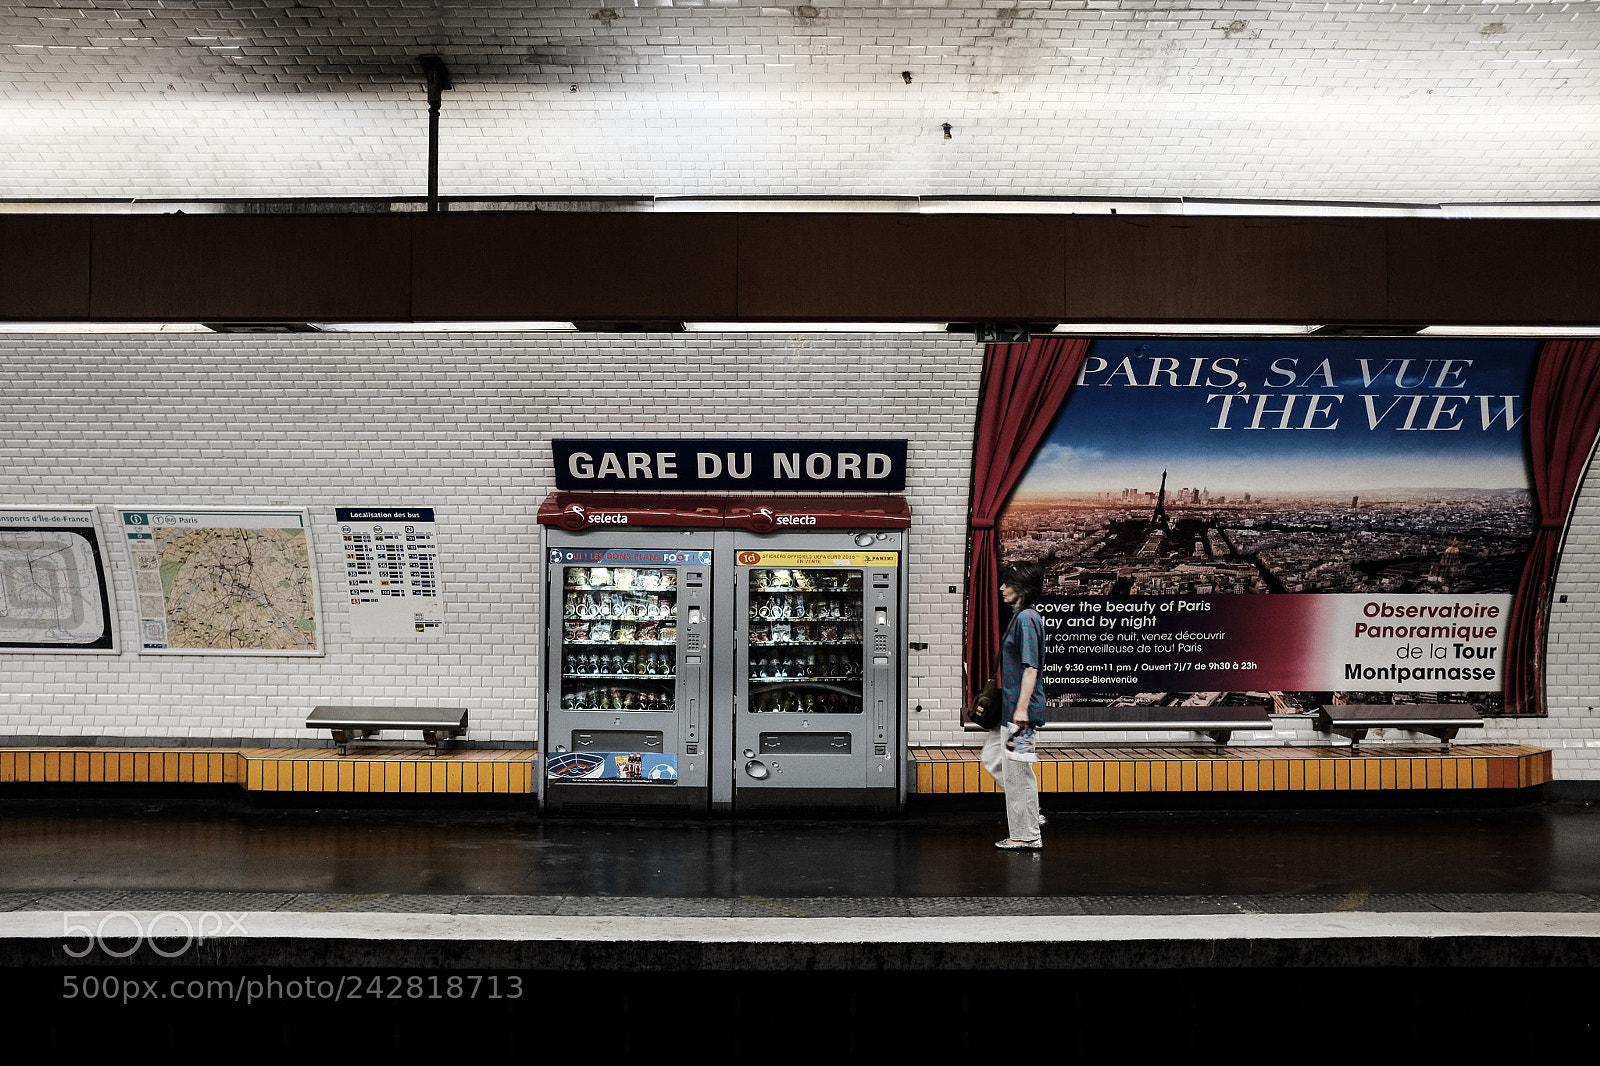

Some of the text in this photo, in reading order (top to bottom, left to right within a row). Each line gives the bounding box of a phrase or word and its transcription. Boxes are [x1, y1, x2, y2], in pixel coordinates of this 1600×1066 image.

[1073, 356, 1474, 394] PARIS, SA VUE
[1206, 394, 1527, 431] THE VIEW
[568, 452, 892, 480] GARE DU NORD
[588, 513, 628, 524] selecta
[776, 514, 816, 525] selecta
[606, 552, 631, 560] BONS
[634, 553, 662, 561] PLANS
[663, 554, 690, 562] FOOT
[744, 552, 756, 564] Ici
[1035, 600, 1211, 614] cover the beauty of Paris
[1363, 602, 1500, 618] Observatoire
[1066, 616, 1095, 627] and
[1100, 616, 1117, 629] by
[1120, 616, 1157, 629] night
[1100, 632, 1114, 641] de
[1141, 633, 1172, 641] venez
[1175, 631, 1226, 640] découvrir
[1354, 622, 1498, 641] Panoramique
[1068, 644, 1134, 653] merveilleuse
[1137, 644, 1151, 653] de
[1154, 644, 1175, 653] tout
[1178, 642, 1202, 652] Paris
[1396, 643, 1497, 660] de la Tour
[1141, 663, 1171, 671] Ouvert
[1174, 663, 1192, 672] 7j/7
[1209, 662, 1230, 670] 9h30
[1344, 664, 1496, 683] Montparnasse
